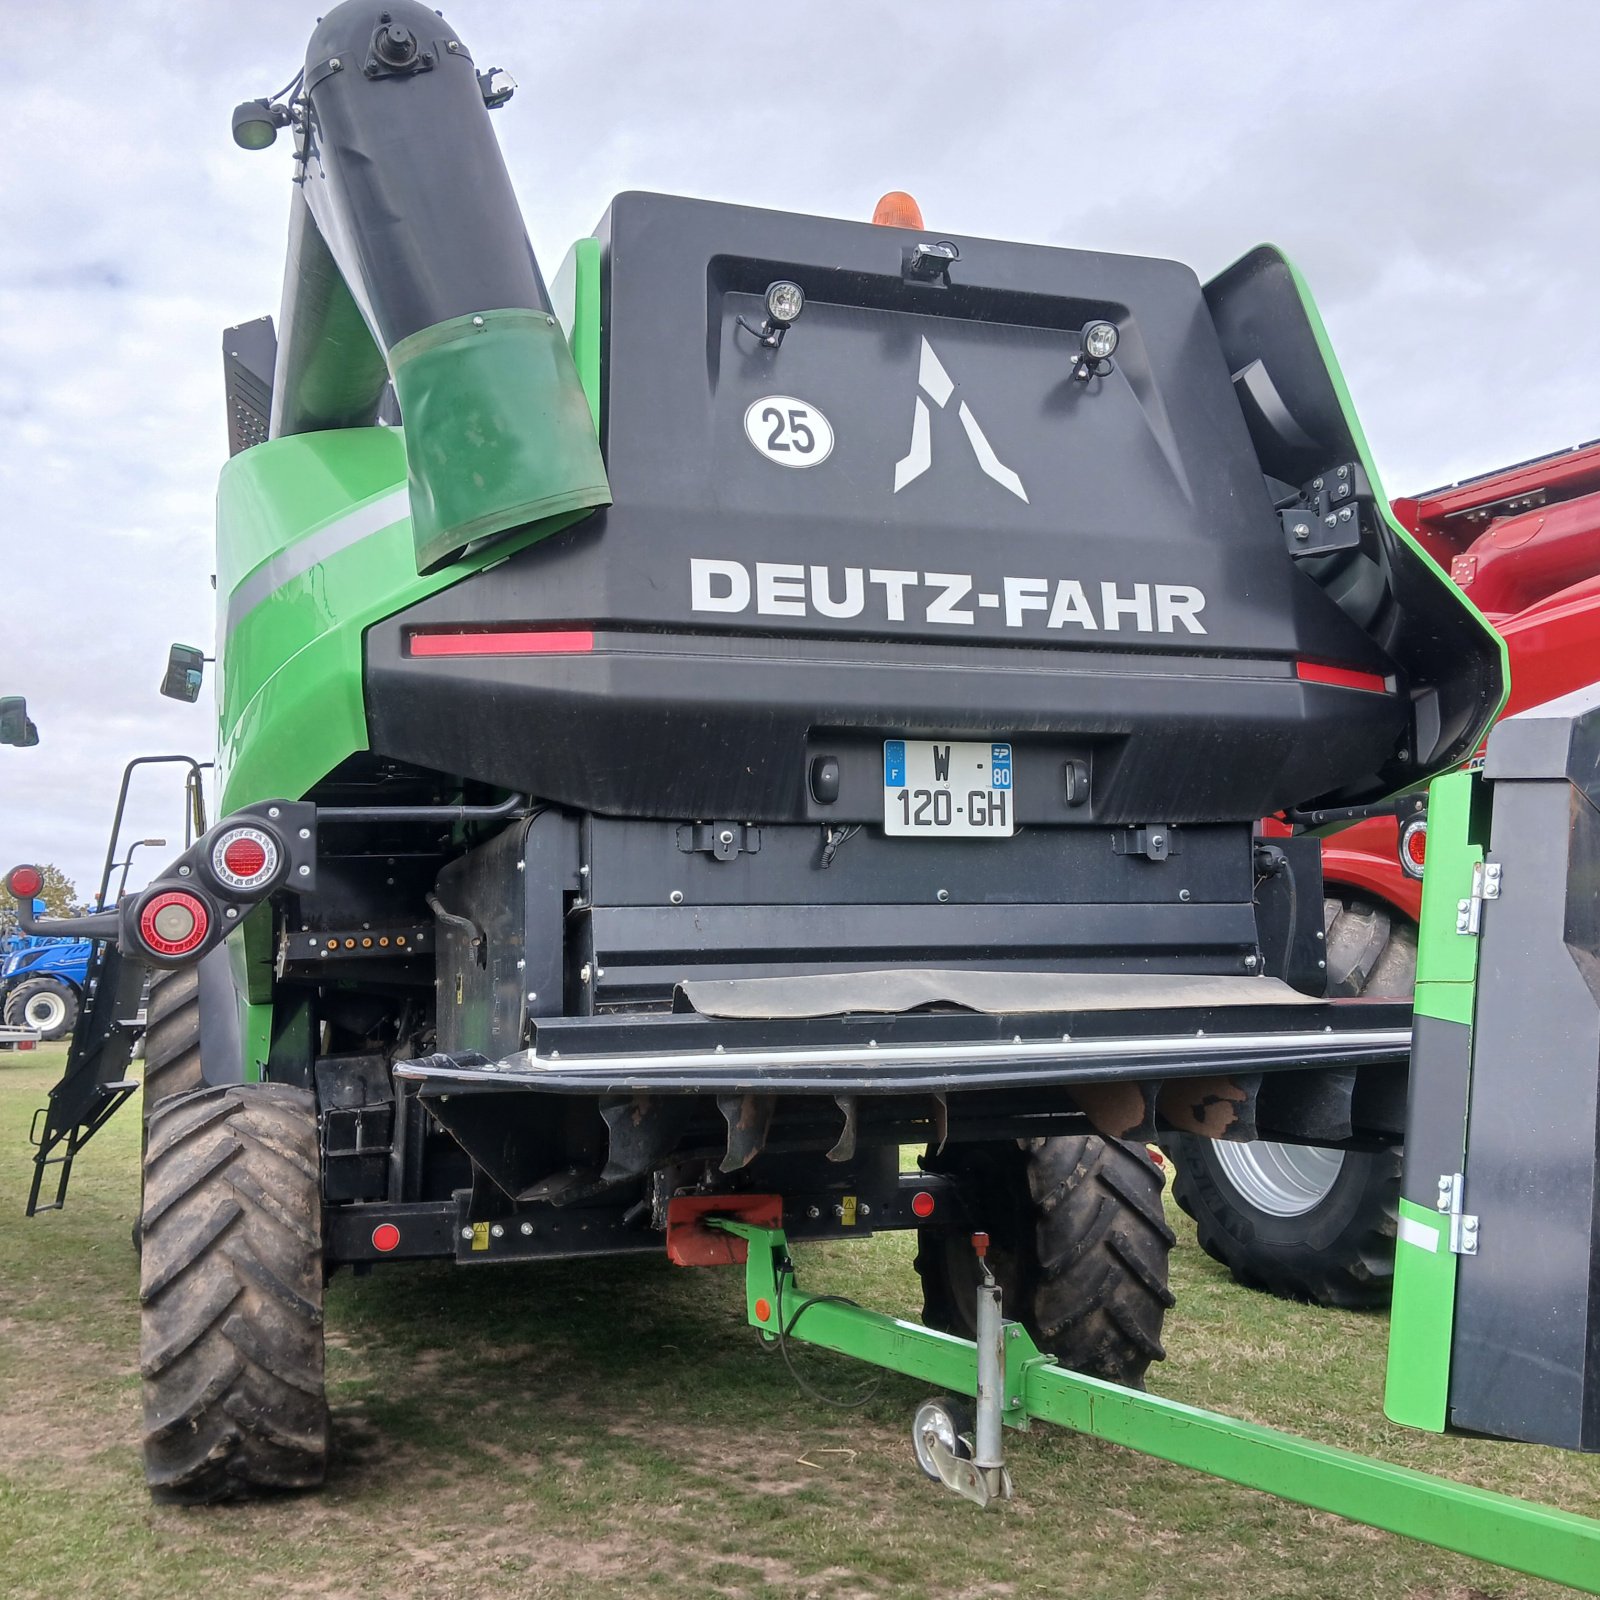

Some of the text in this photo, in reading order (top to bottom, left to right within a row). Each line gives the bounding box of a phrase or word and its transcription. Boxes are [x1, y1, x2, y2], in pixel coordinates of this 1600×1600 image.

[762, 407, 815, 454] 25
[690, 557, 1208, 635] DEUTZ-FAHR
[891, 769, 898, 780] F
[933, 745, 951, 782] W
[993, 768, 1010, 786] 80
[897, 789, 1006, 826] 120-GH
